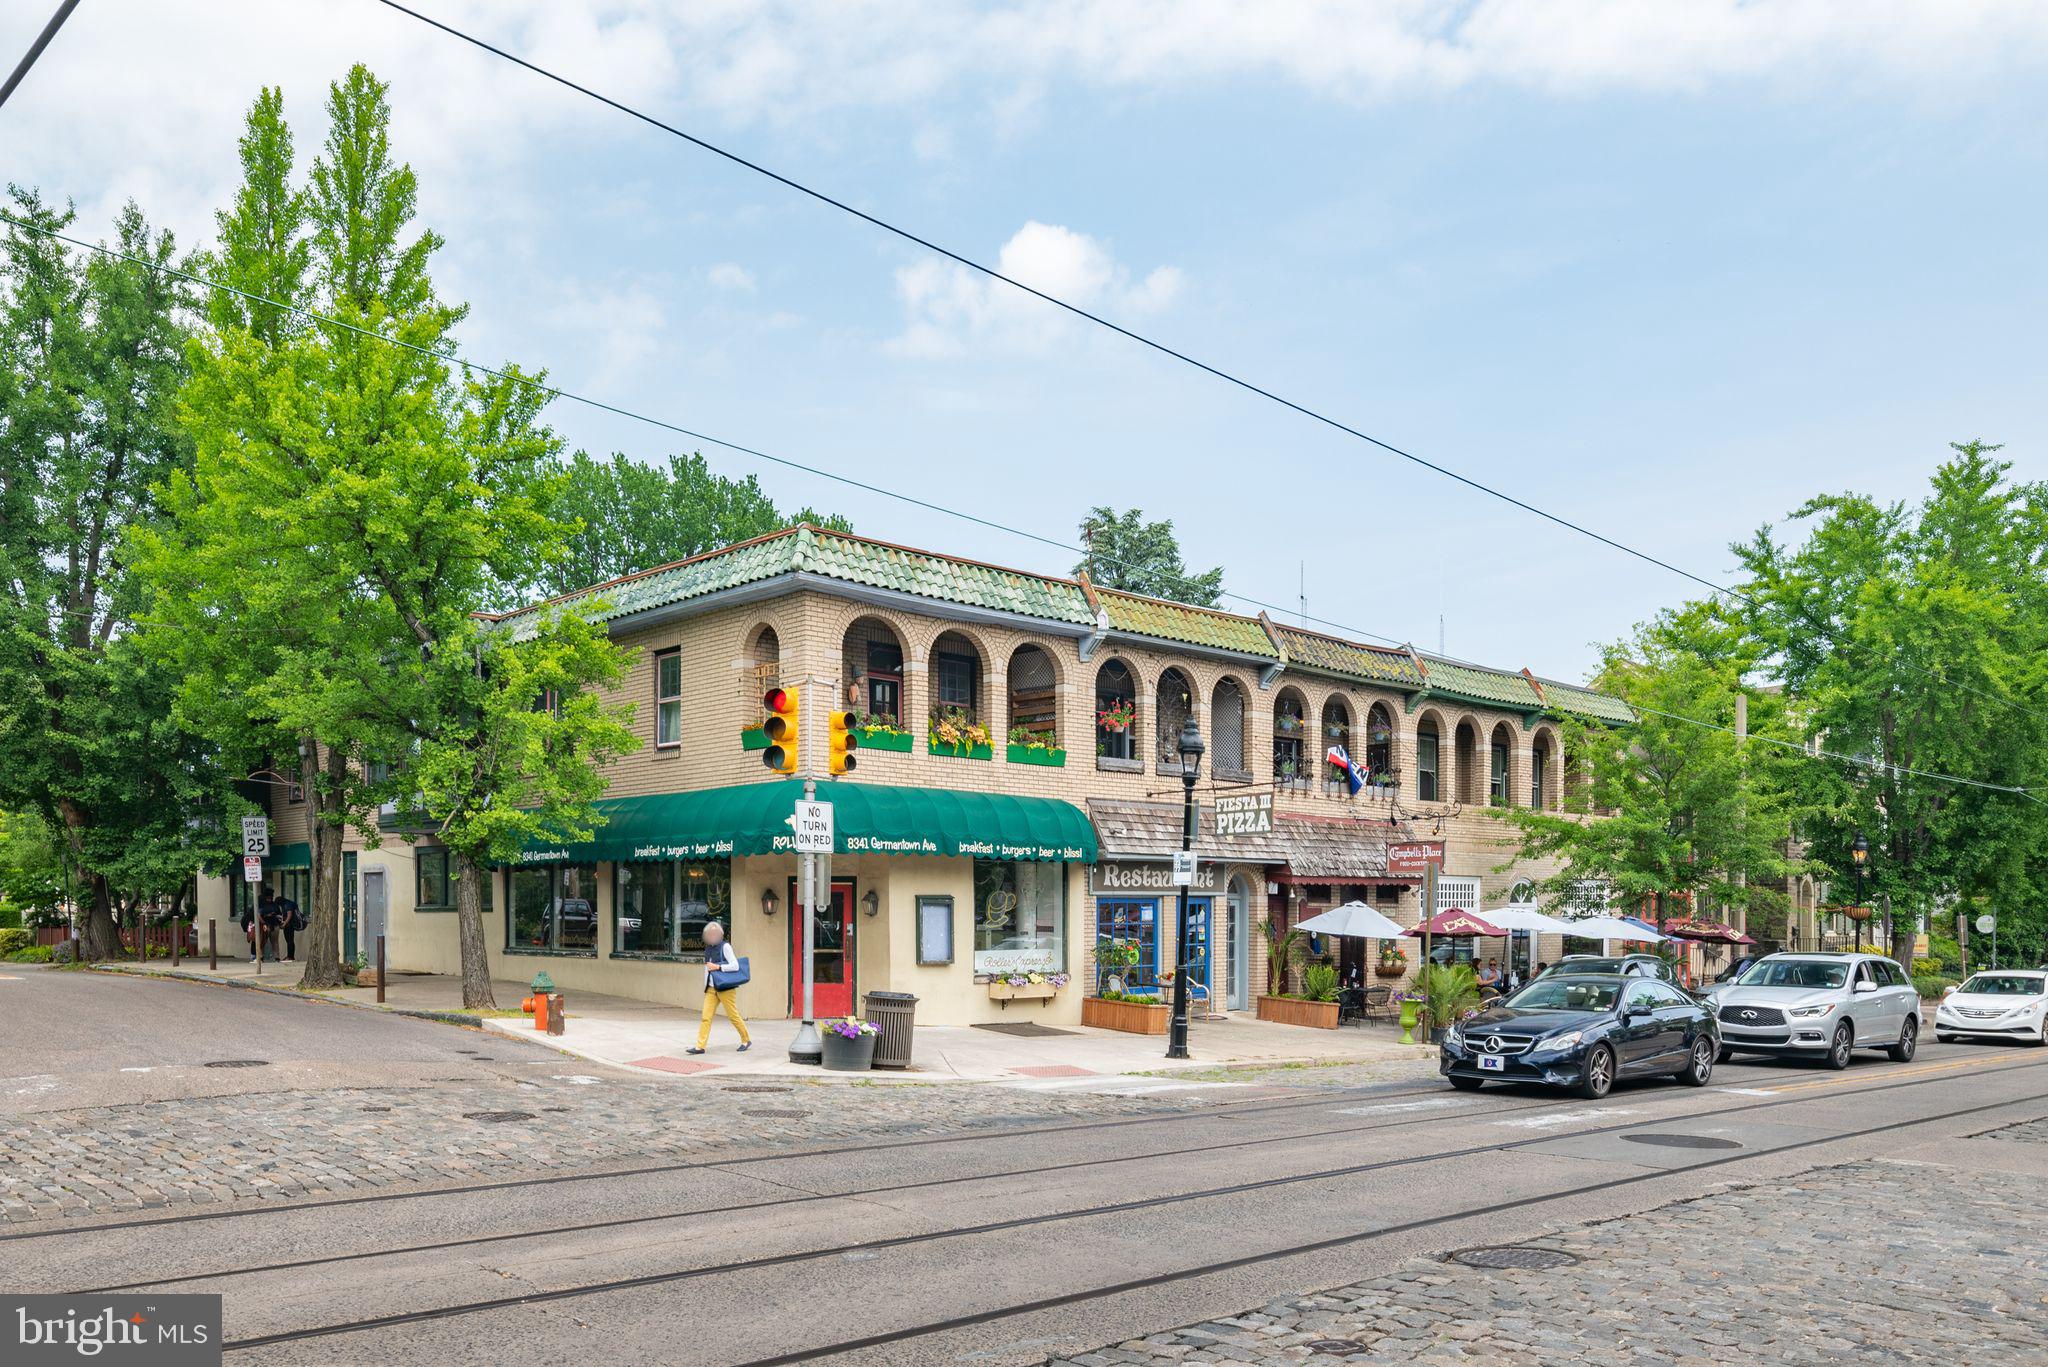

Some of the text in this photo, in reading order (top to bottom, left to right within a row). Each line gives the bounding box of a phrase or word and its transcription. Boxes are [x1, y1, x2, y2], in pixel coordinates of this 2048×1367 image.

[1215, 794, 1271, 812] FIESTA III
[808, 807, 821, 817] NO
[803, 820, 827, 831] TURN
[1216, 810, 1271, 834] PIZZA
[247, 838, 265, 852] 25
[772, 836, 797, 850] ROLL
[799, 834, 831, 845] ON RED
[847, 836, 937, 851] 8341 Germantown Ave
[634, 844, 660, 858] breakfast
[666, 844, 689, 858] burgers
[695, 842, 710, 855] beer
[959, 841, 994, 854] breakfast
[1002, 844, 1031, 857] burgers
[1038, 846, 1055, 857] beer
[1422, 844, 1442, 860] Place
[1103, 864, 1214, 888] Restaunt
